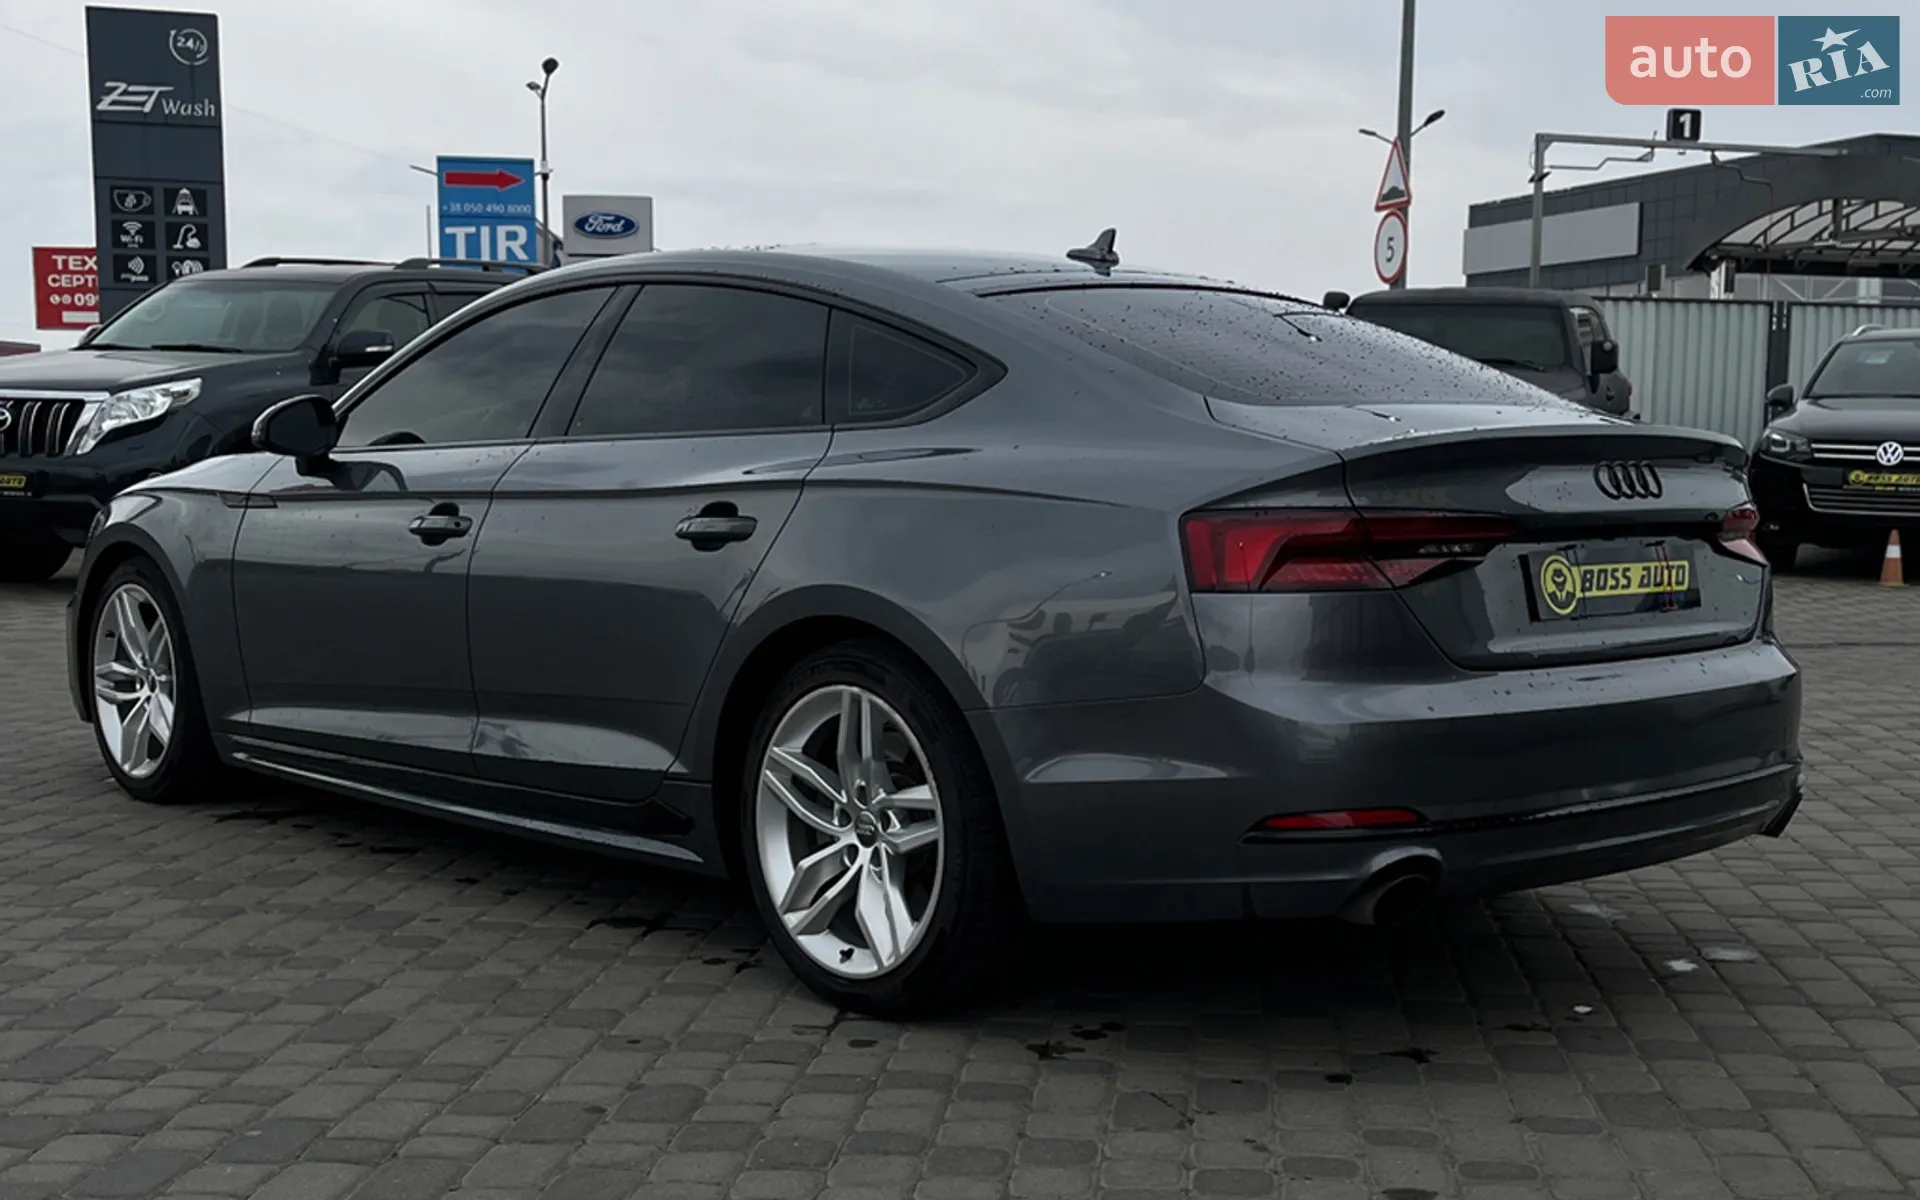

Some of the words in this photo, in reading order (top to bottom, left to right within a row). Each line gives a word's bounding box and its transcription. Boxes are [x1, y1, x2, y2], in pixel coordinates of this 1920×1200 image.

[96, 81, 174, 113] ZET
[162, 98, 215, 117] Wash
[1678, 112, 1691, 138] 1
[584, 214, 624, 233] Ford
[445, 225, 529, 260] TIR
[1386, 236, 1395, 263] 5
[1581, 567, 1632, 592] BOSS
